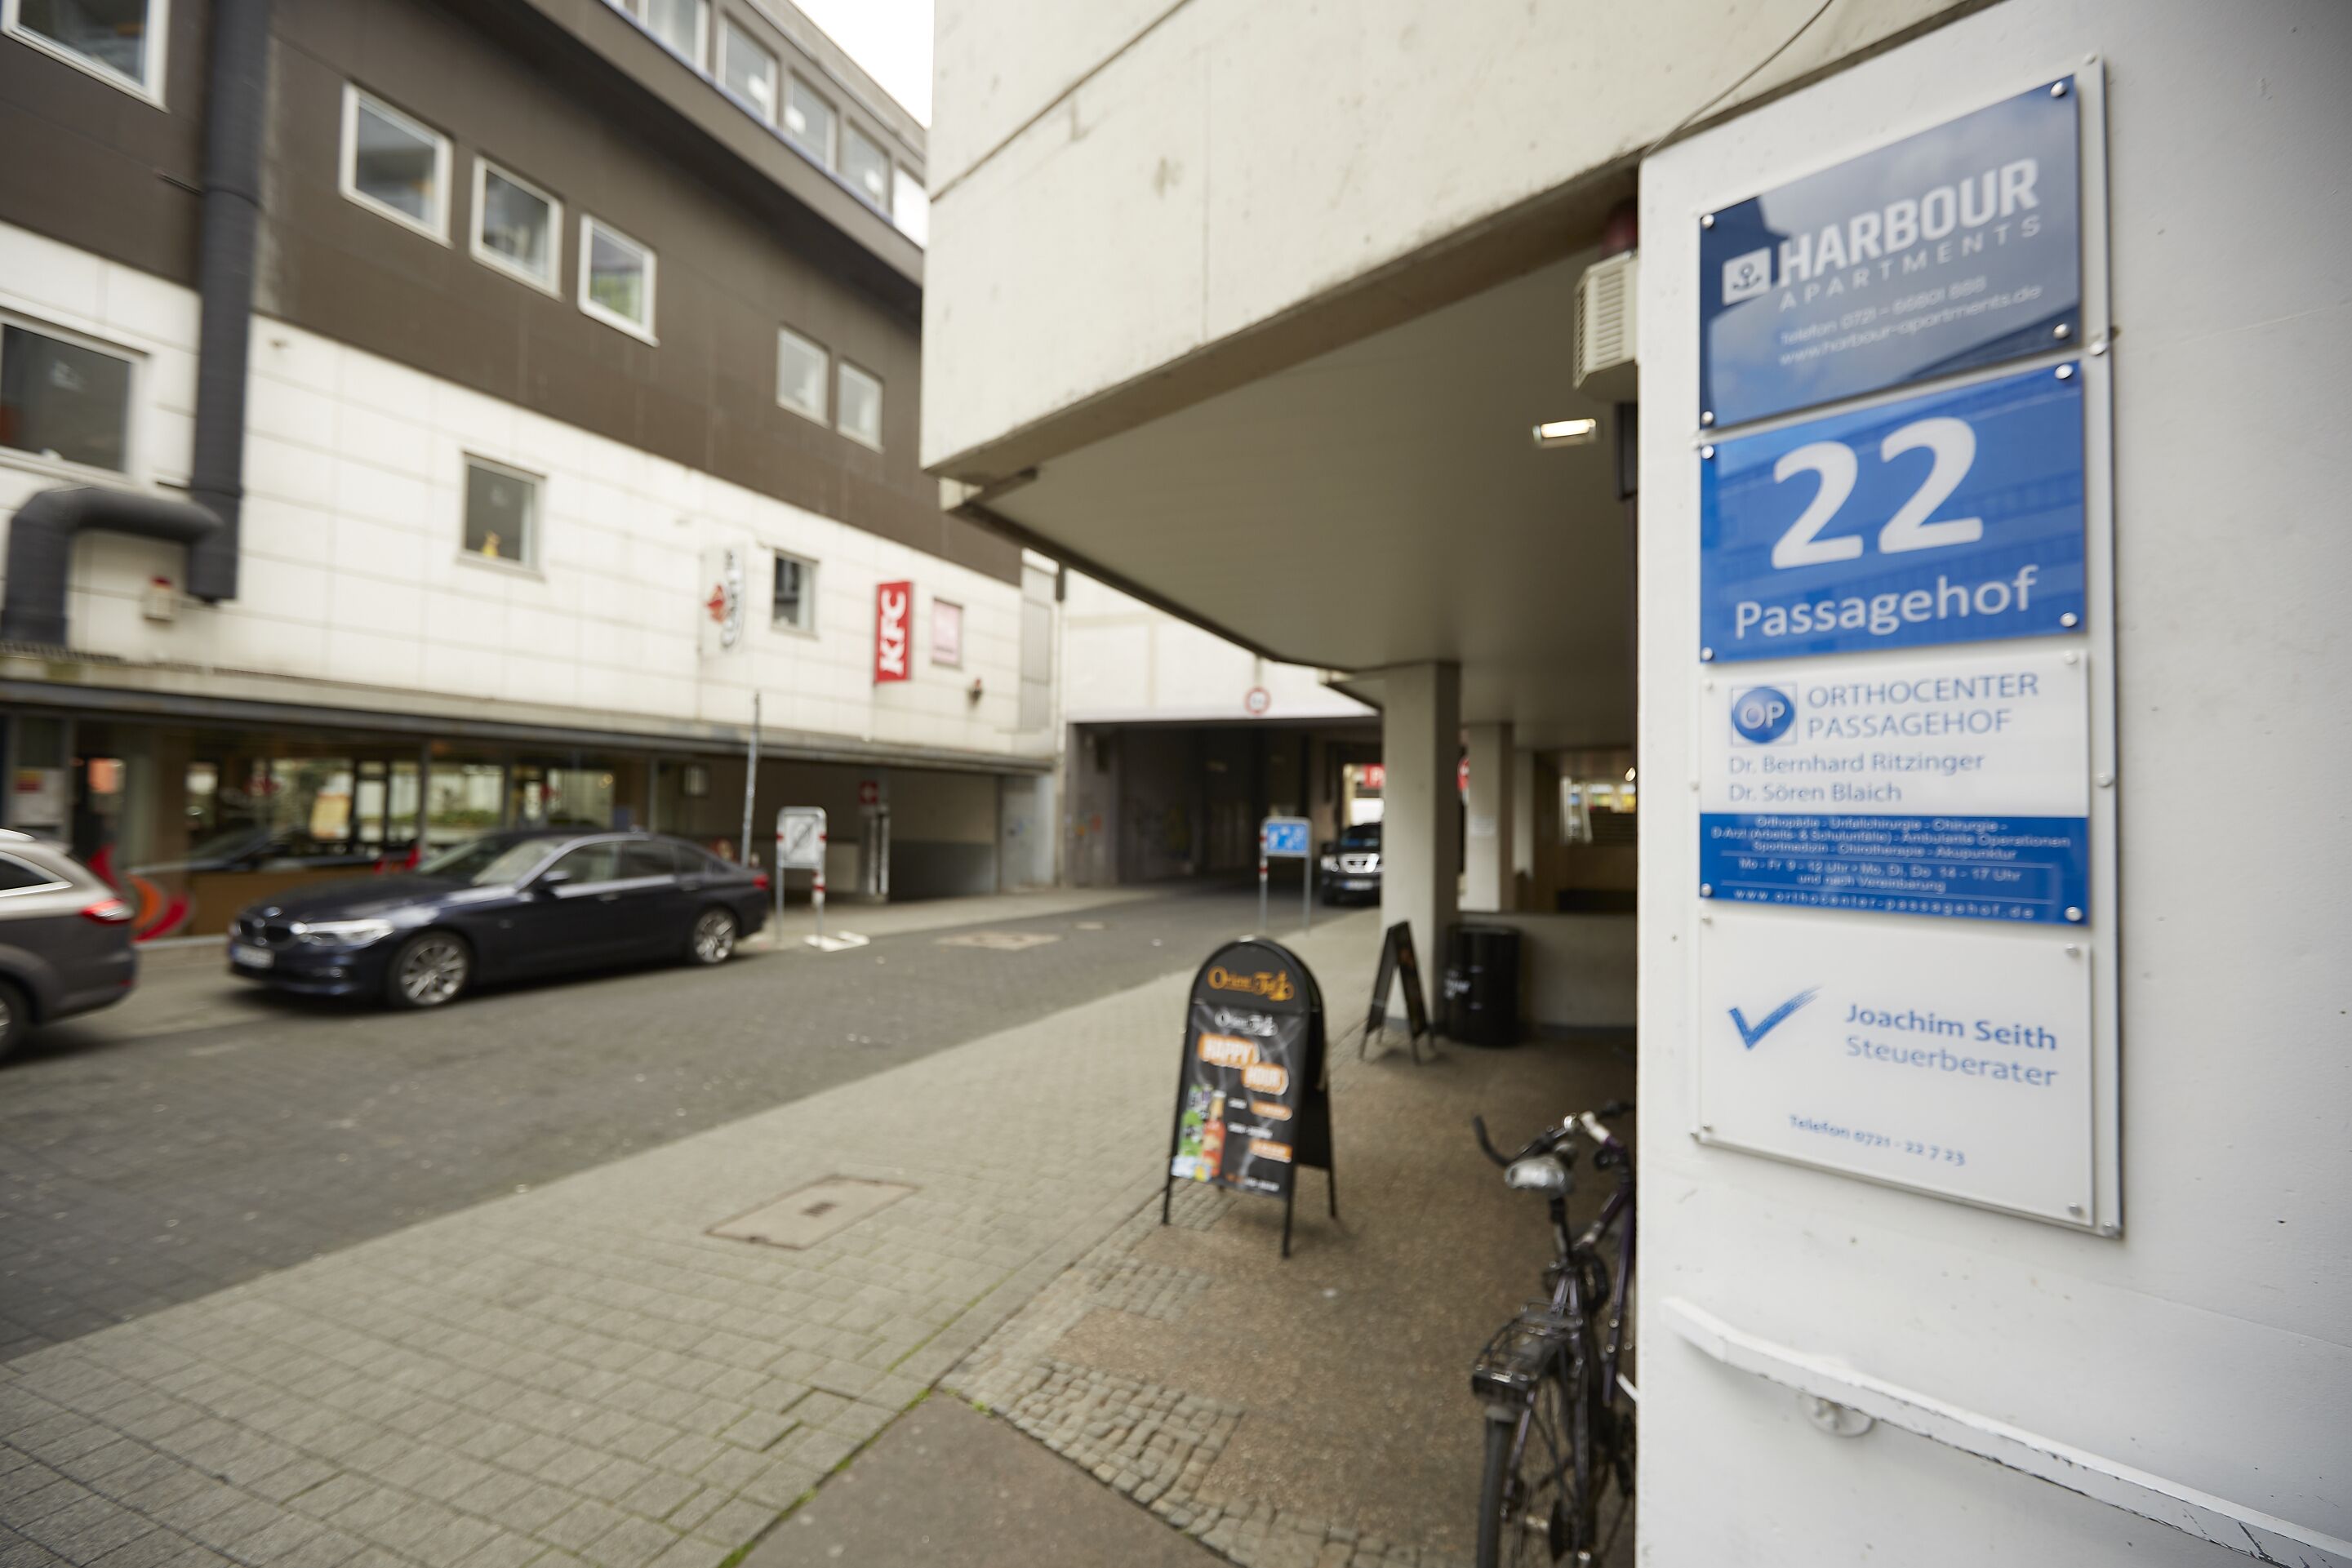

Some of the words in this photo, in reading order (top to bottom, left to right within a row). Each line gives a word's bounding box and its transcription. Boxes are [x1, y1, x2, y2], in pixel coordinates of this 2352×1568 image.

[1778, 159, 2039, 287] HARBOUR
[1779, 215, 2041, 313] APARTMENTS
[1770, 416, 1984, 570] 22
[1735, 564, 2039, 640] Passagehof
[880, 589, 907, 677] KFC
[1807, 672, 2040, 708] ORTHOCENTER
[1740, 700, 1786, 729] OP
[1808, 708, 2012, 740] PASSAGEHOF
[1728, 756, 1757, 775] Dr.
[1763, 753, 1865, 774] Bernhard
[1872, 752, 1985, 775] Ritzinger
[1728, 784, 1757, 802] Dr.
[1763, 783, 1825, 802] Sören
[1832, 782, 1902, 802] Blaich
[1932, 818, 1999, 835] Chirurgie
[1976, 833, 2071, 848] Operationen
[1798, 873, 1821, 885] und
[1856, 877, 1946, 895] Vereinbarung
[1825, 861, 1850, 874] Uhr
[1992, 867, 2022, 882] Uhr
[1845, 1004, 1965, 1037] Joachim
[1975, 1019, 2058, 1051] Seith
[1845, 1035, 2059, 1087] Steuerberater
[1789, 1114, 1850, 1139] Telefon
[1853, 1130, 1891, 1147] 0721
[1905, 1140, 1924, 1156] 22
